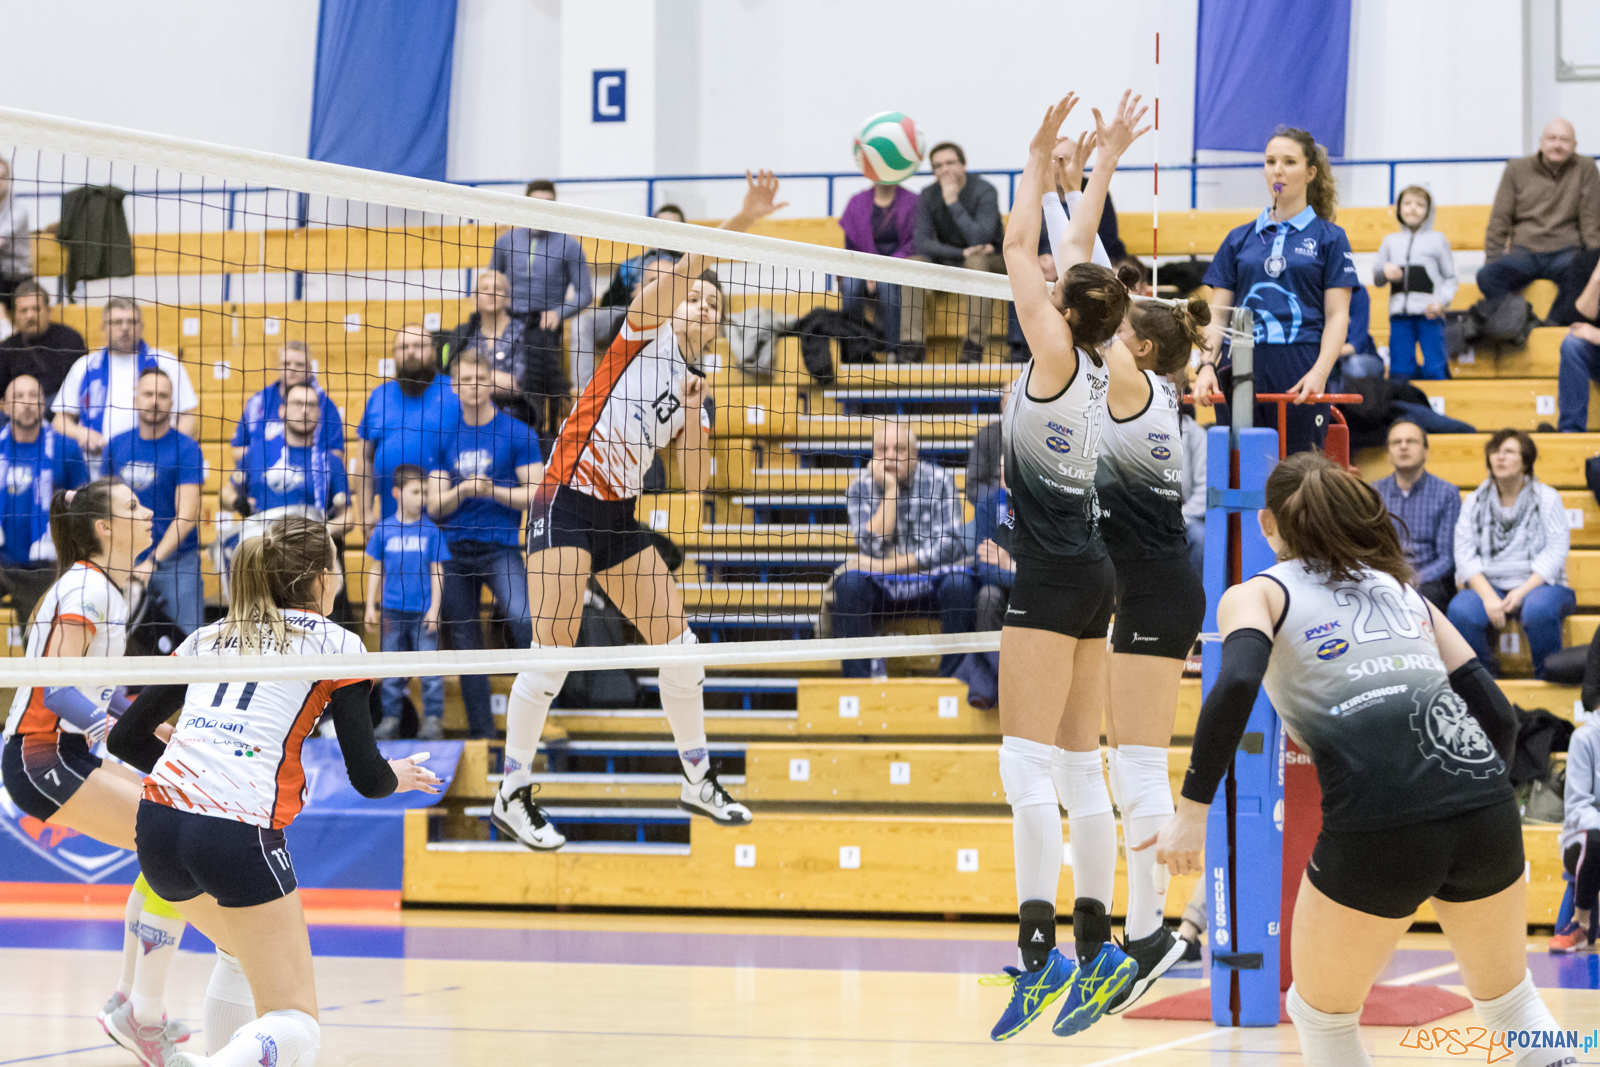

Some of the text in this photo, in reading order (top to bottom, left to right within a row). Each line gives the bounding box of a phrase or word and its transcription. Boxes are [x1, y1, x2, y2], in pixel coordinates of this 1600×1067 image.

[598, 76, 621, 116] C
[1334, 585, 1421, 644] 20
[1339, 684, 1408, 711] KIRCHHOFF
[44, 768, 61, 787] 7
